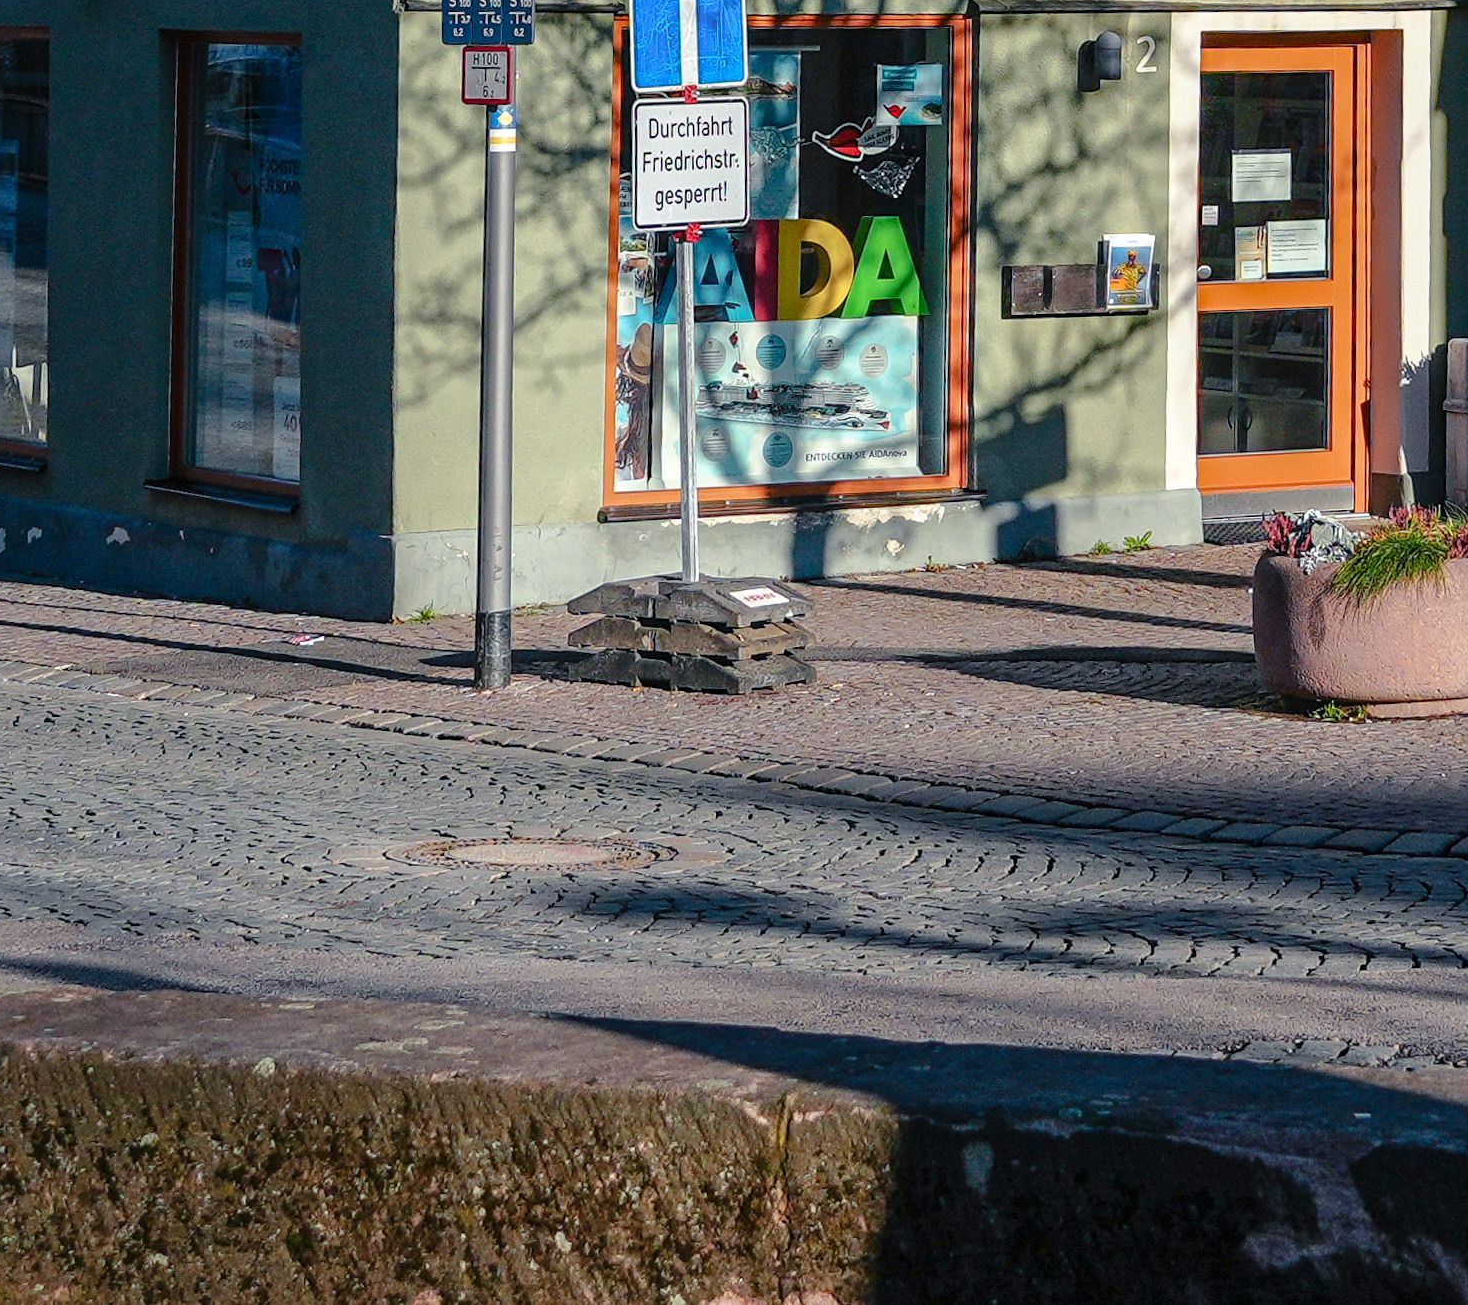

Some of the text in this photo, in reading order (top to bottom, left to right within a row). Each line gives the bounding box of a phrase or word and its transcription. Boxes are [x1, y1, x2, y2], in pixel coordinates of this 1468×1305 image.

[1136, 36, 1157, 72] 2
[649, 115, 733, 139] Durchfahrt
[642, 149, 740, 173] Friedrichstr.
[655, 180, 727, 212] gesperrt!
[652, 216, 930, 324] AIDA
[805, 451, 853, 462] ENTDECKEN
[854, 450, 867, 460] SIE
